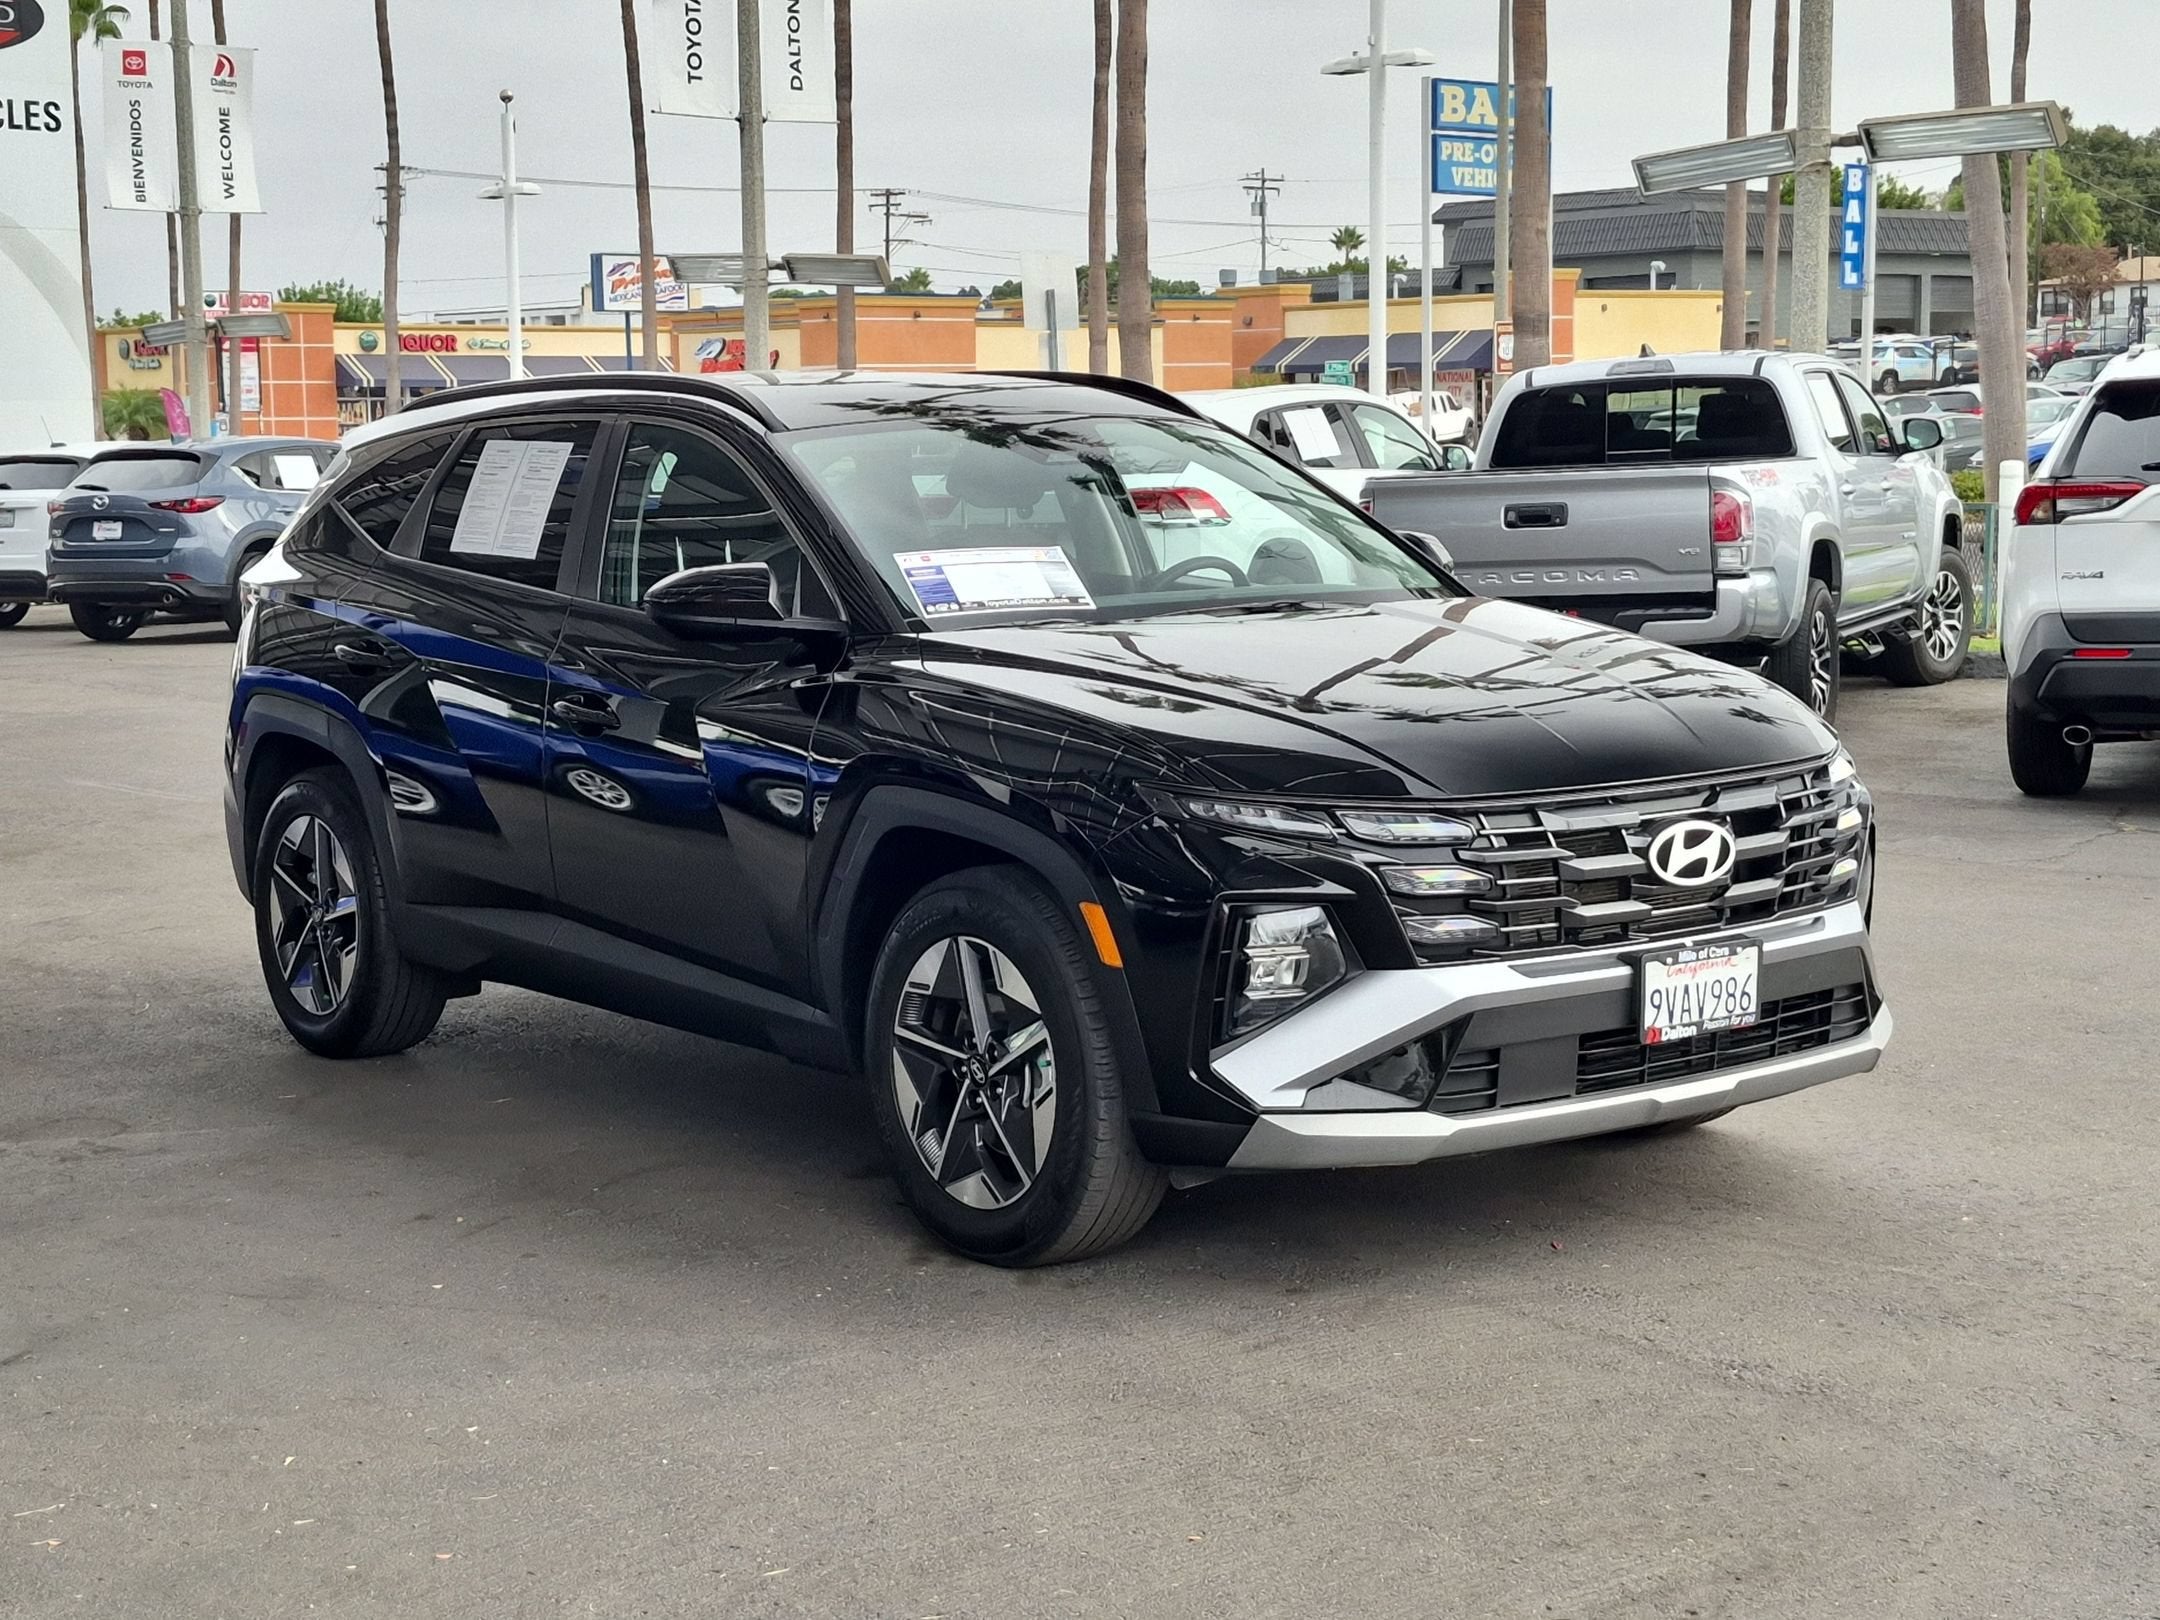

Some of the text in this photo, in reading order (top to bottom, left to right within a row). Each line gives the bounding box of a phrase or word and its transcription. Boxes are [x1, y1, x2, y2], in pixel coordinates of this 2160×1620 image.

[685, 0, 704, 84] TOYOT
[787, 0, 804, 91] DALTON
[117, 79, 153, 89] TOYOTA
[210, 77, 238, 88] Dalton
[0, 99, 62, 132] LES
[130, 99, 147, 202] BIENVENIDOS
[219, 106, 235, 199] WELCOME
[1844, 168, 1862, 284] BALL
[398, 334, 458, 352] IQUOR
[1436, 371, 1473, 383] NATIONAL
[1448, 385, 1462, 397] CITY
[1454, 567, 1641, 585] TACOMA
[1678, 946, 1729, 962] Mile of Cars
[1666, 957, 1738, 979] California
[1650, 973, 1753, 1026] 9VAV986
[1661, 1025, 1697, 1041] Dalton
